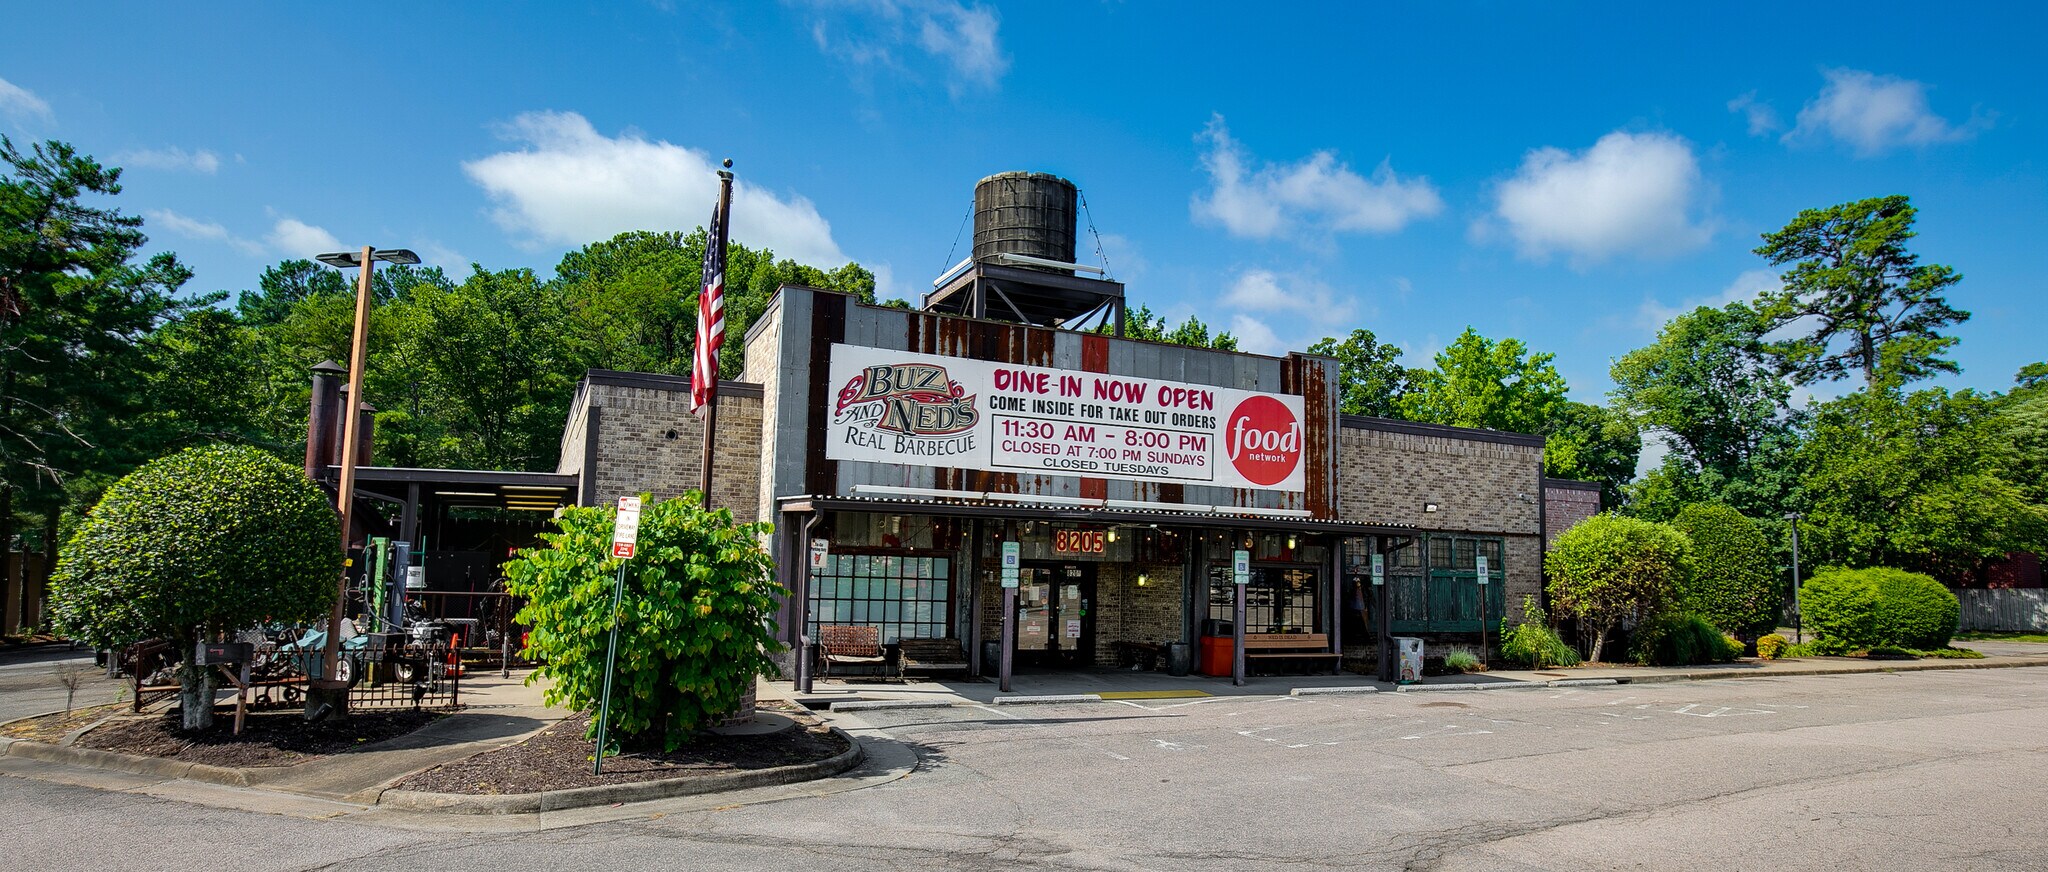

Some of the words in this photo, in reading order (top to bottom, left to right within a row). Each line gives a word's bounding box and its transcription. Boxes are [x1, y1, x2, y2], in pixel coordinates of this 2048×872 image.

[866, 364, 947, 397] BUZ
[993, 369, 1082, 398] DINE-IN
[1094, 378, 1148, 404] NOW
[1157, 385, 1214, 411] OPEN
[834, 402, 884, 424] AND
[886, 396, 976, 436] NED'S
[989, 395, 1026, 412] COME
[1033, 399, 1075, 416] INSIDE
[1081, 404, 1104, 419] FOR
[1109, 406, 1139, 422] TAKE
[1144, 410, 1167, 424] OUT
[1172, 413, 1216, 430] ORDERS
[845, 426, 886, 450] REAL
[894, 434, 976, 456] BARBECUE
[1002, 420, 1055, 439] 11:30
[1063, 425, 1095, 442] AM
[1125, 430, 1170, 449] 8:00
[1179, 435, 1206, 452] PM
[1231, 416, 1298, 461] food
[1002, 440, 1061, 455] CLOSED
[1066, 445, 1083, 457] AT
[1087, 446, 1117, 460] 7:00
[1122, 449, 1141, 461] PM
[1147, 451, 1205, 466] SUNDAYS
[1043, 458, 1099, 470] CLOSED
[1104, 462, 1169, 475] TUESDAYS
[1249, 453, 1286, 463] network
[1056, 531, 1104, 552] 8205
